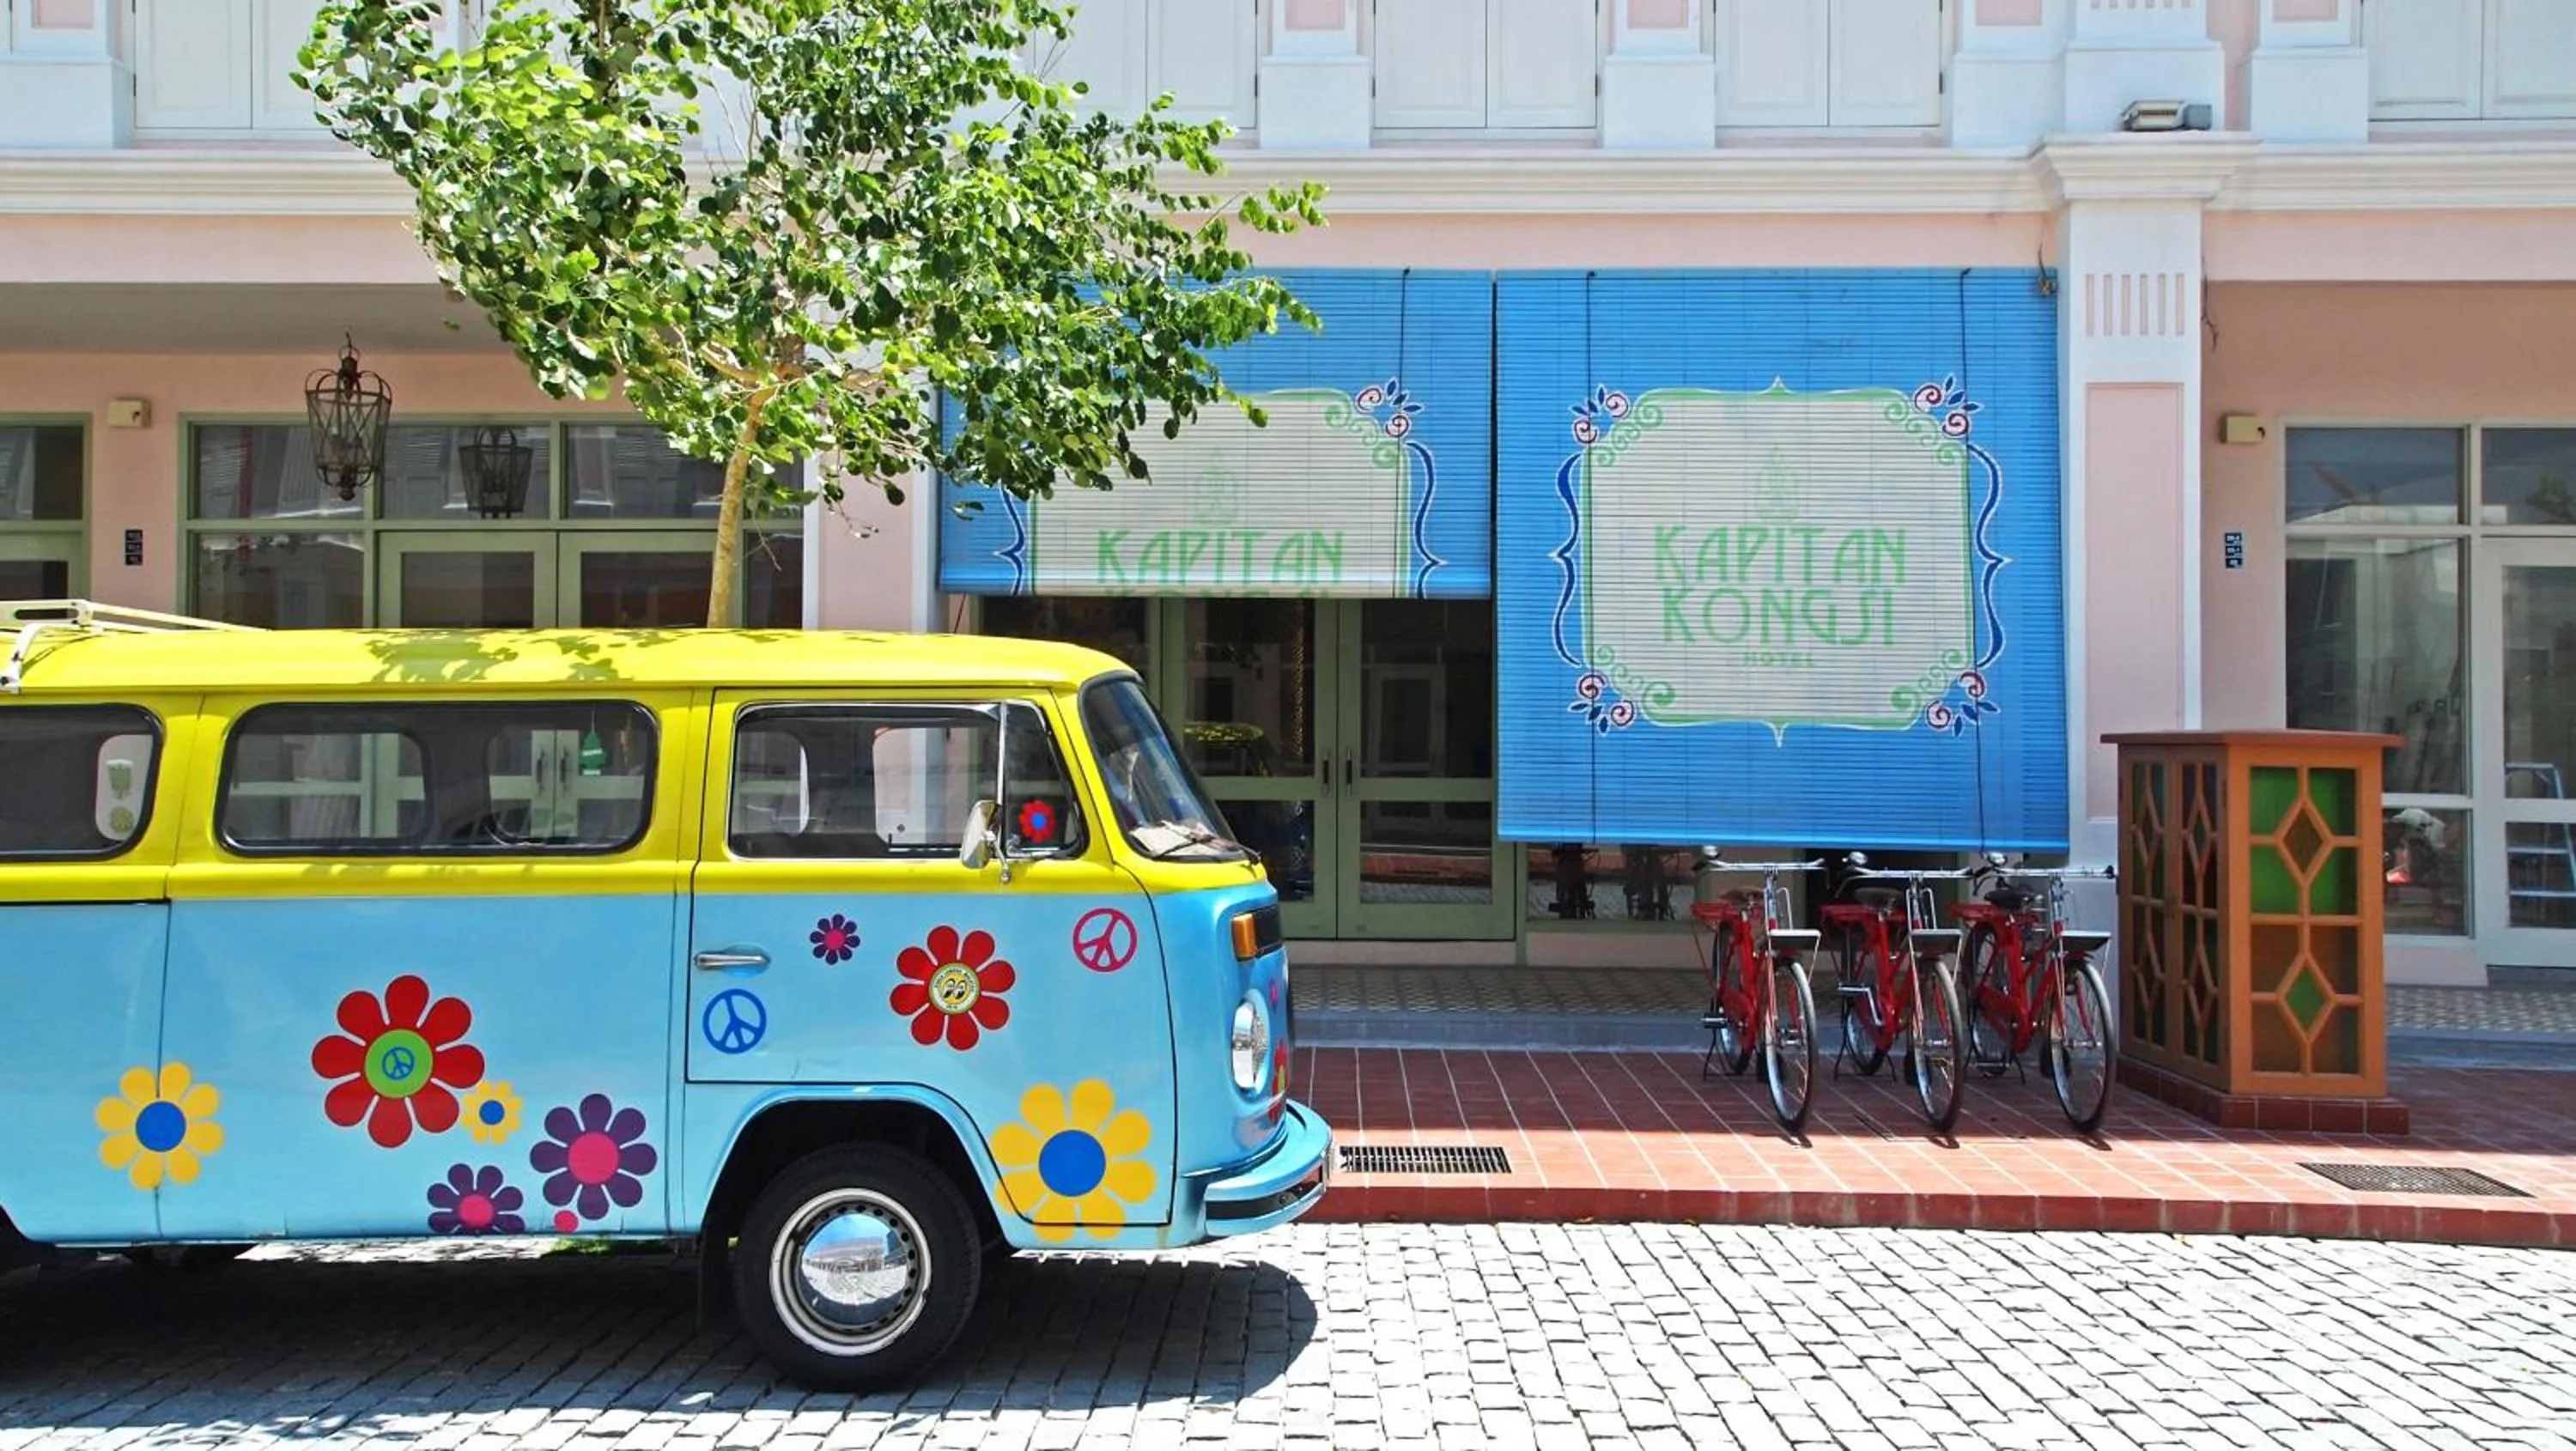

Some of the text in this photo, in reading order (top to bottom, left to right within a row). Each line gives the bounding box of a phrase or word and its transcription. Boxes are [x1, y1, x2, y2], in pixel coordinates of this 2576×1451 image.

[1097, 530, 1346, 585] KAPITAN
[1653, 525, 1905, 584] KAPITAN
[1663, 587, 1893, 646] KONGSI
